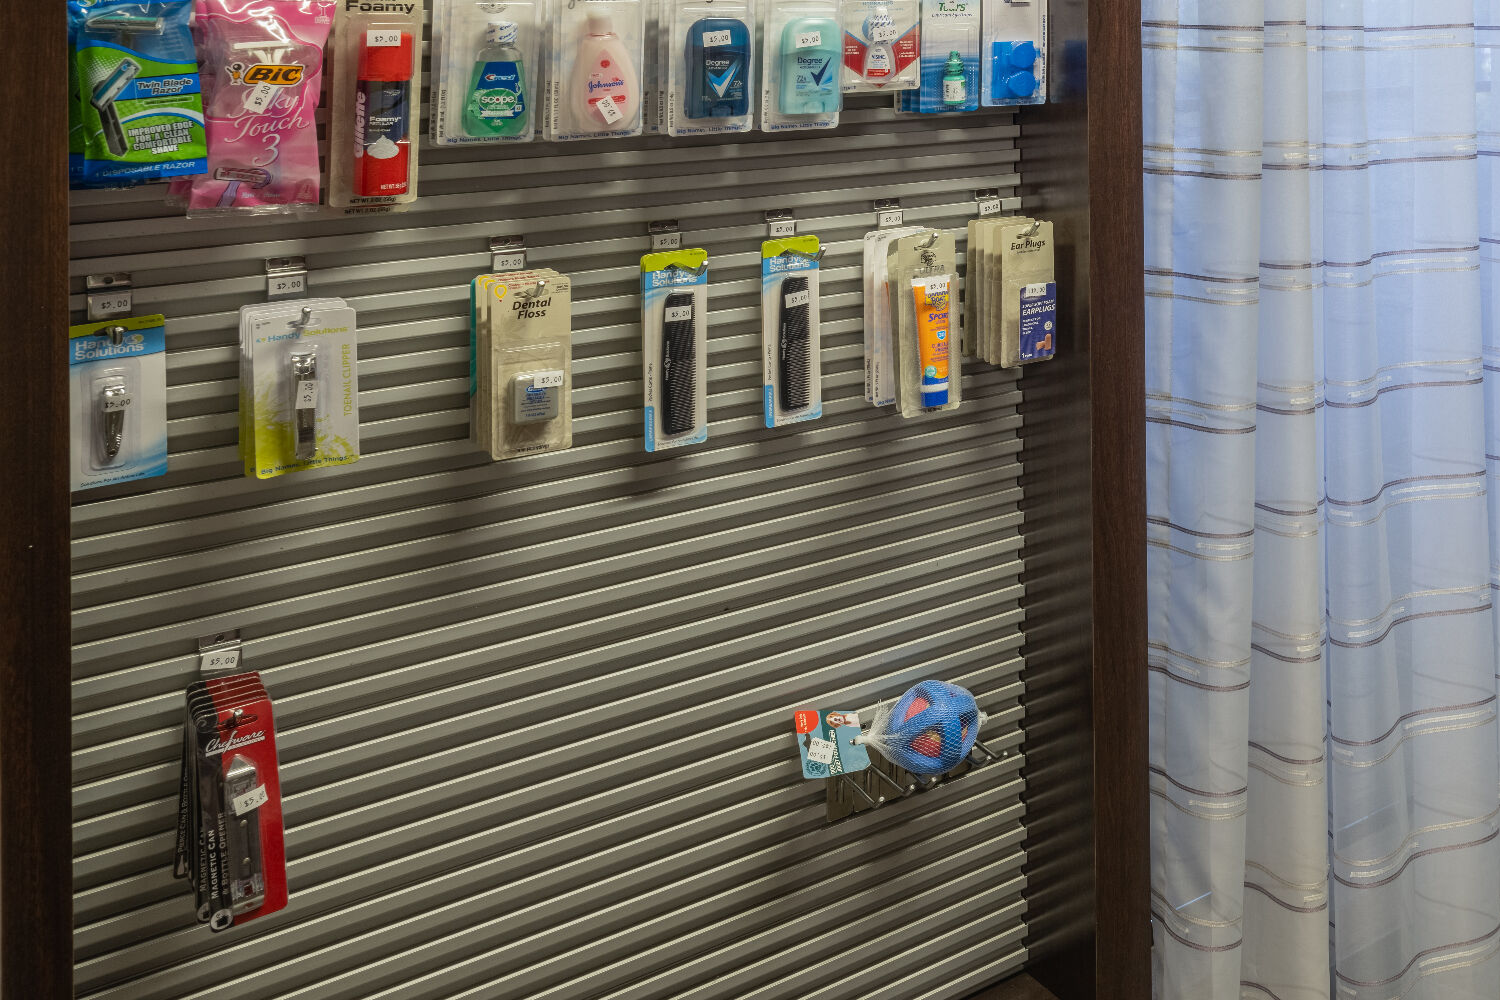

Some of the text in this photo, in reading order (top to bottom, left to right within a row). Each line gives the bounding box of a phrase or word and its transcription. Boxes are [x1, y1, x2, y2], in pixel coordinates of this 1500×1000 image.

[345, 0, 415, 14] Foamy
[375, 35, 398, 43] $5.00
[797, 57, 823, 65] Degree
[137, 78, 192, 90] Twin Blade
[152, 86, 181, 95] Razor
[482, 95, 514, 104] scope
[128, 121, 193, 137] IMPROVED EDGE
[225, 112, 310, 143] Touch
[133, 134, 192, 150] COMFORTABLE
[152, 145, 178, 154] SHAVE
[252, 134, 279, 167] 3
[162, 161, 195, 169] RAZOR
[1011, 239, 1045, 250] Ear Plugs
[769, 261, 810, 272] Solutions
[277, 281, 301, 290] $5.00
[652, 276, 697, 287] Solutions
[102, 300, 128, 309] $5.00
[512, 298, 551, 311] Dental
[1022, 304, 1055, 316] EARPLUGS
[518, 310, 546, 319] Floss
[268, 326, 348, 342] Handy Solutions
[75, 342, 144, 360] Solutions
[210, 656, 235, 665] $5.00
[206, 730, 264, 753] Chefware
[211, 851, 219, 899] MAGNETIC
